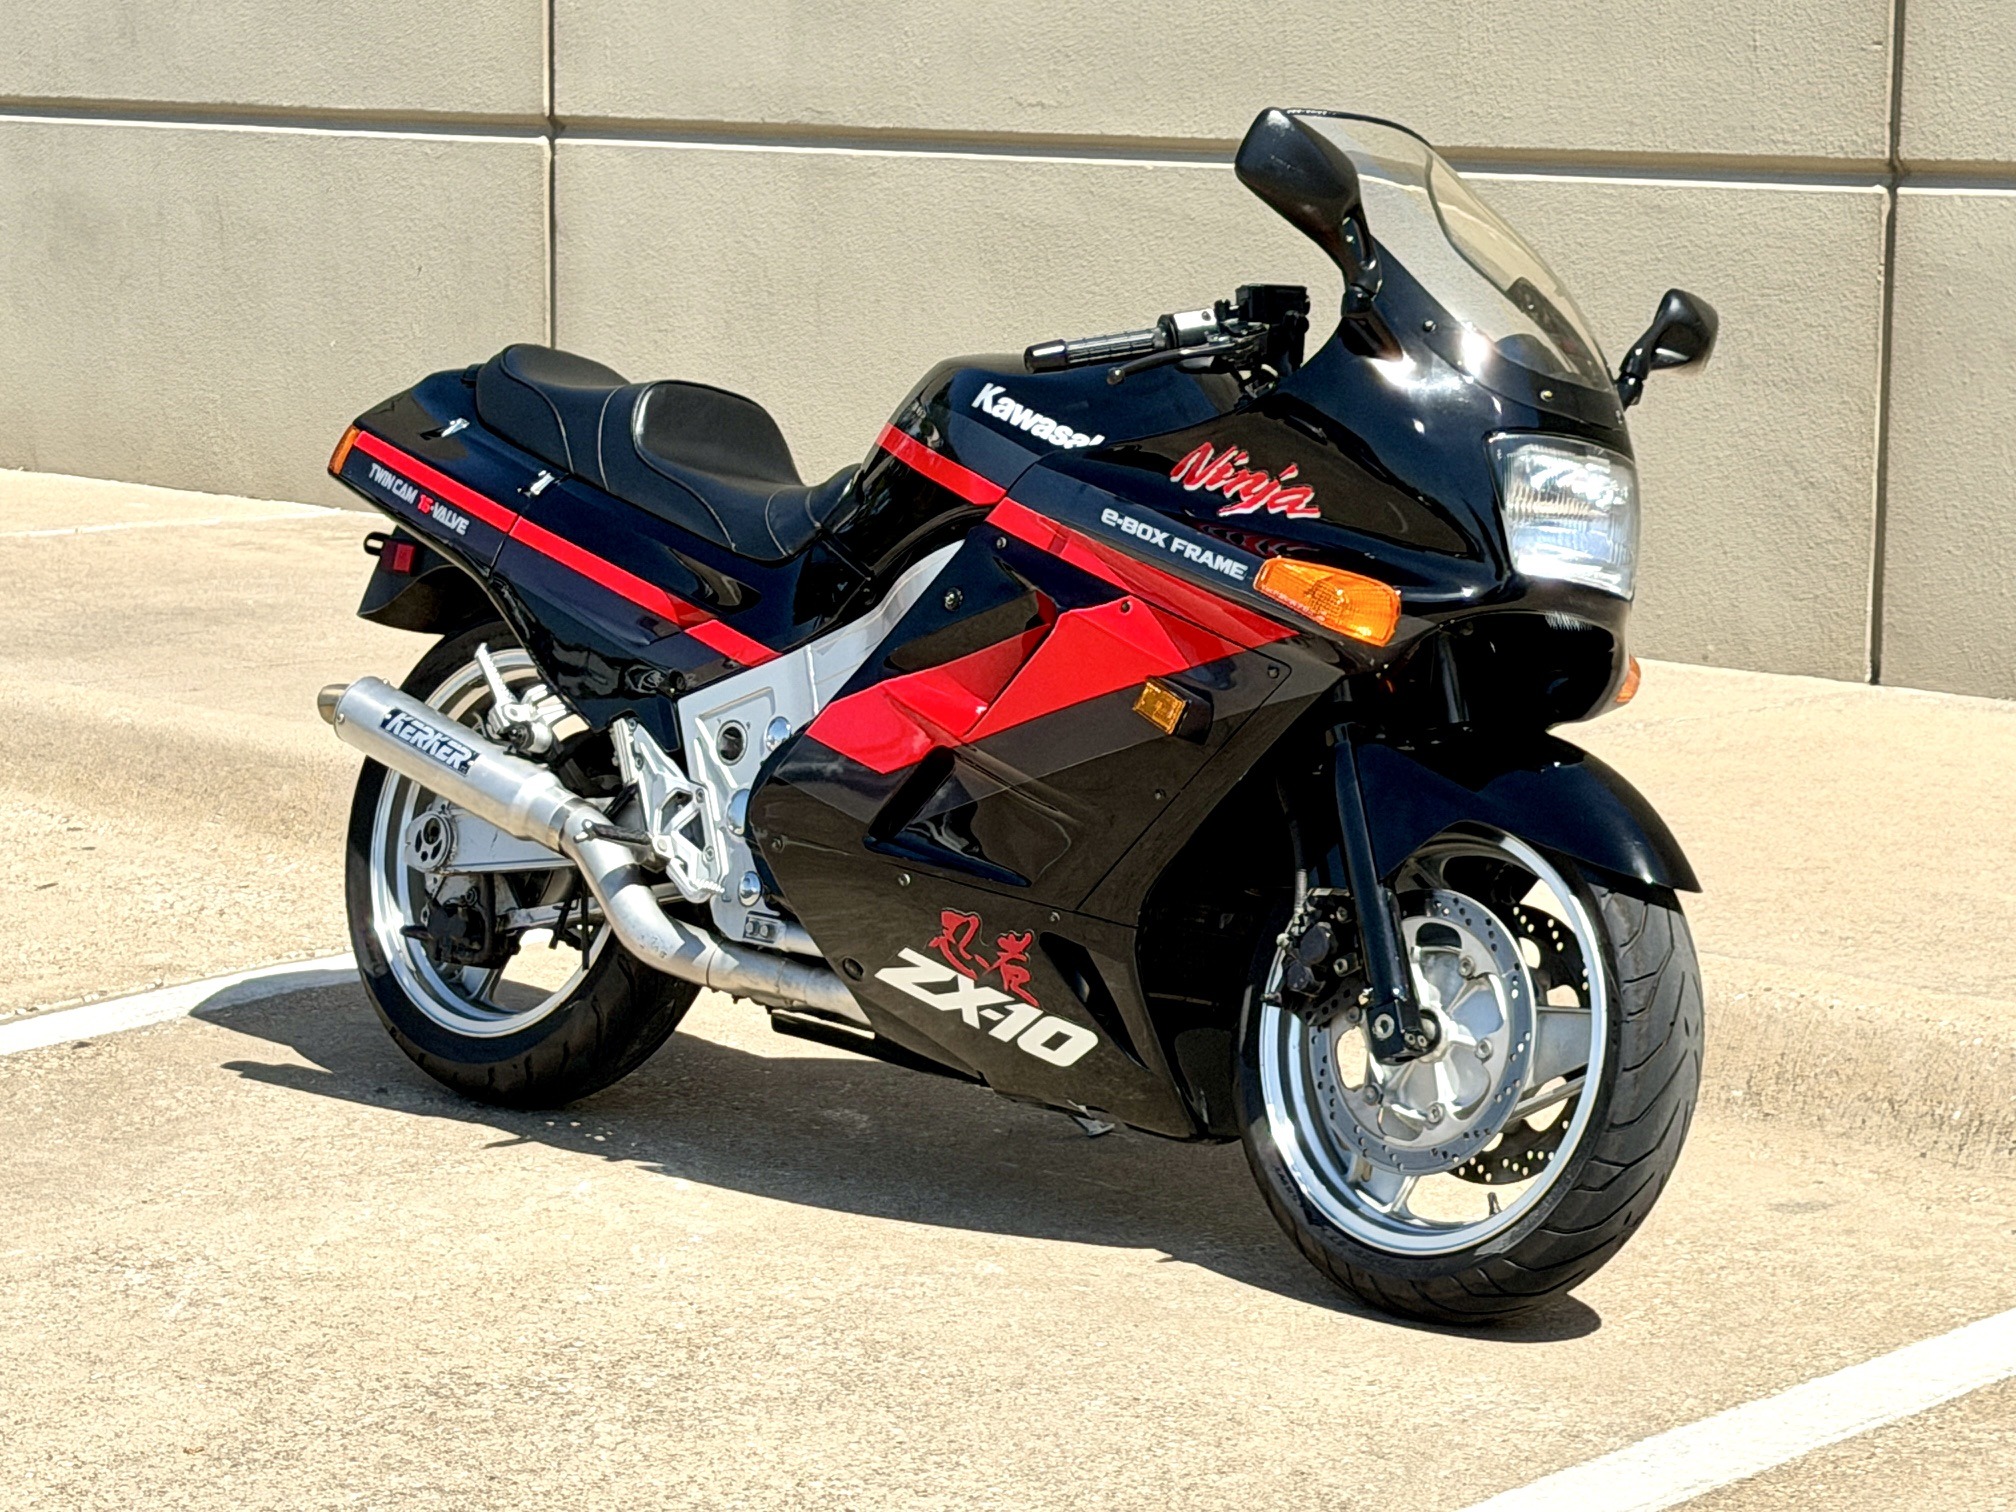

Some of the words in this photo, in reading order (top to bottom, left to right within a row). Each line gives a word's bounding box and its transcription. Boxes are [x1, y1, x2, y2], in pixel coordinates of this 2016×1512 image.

[368, 462, 396, 490] TWIN
[391, 479, 418, 504] CAM
[1170, 442, 1321, 519] Ninja
[1170, 536, 1248, 581] FRAME
[385, 712, 473, 770] KERKER
[875, 947, 1099, 1067] ZX-10
